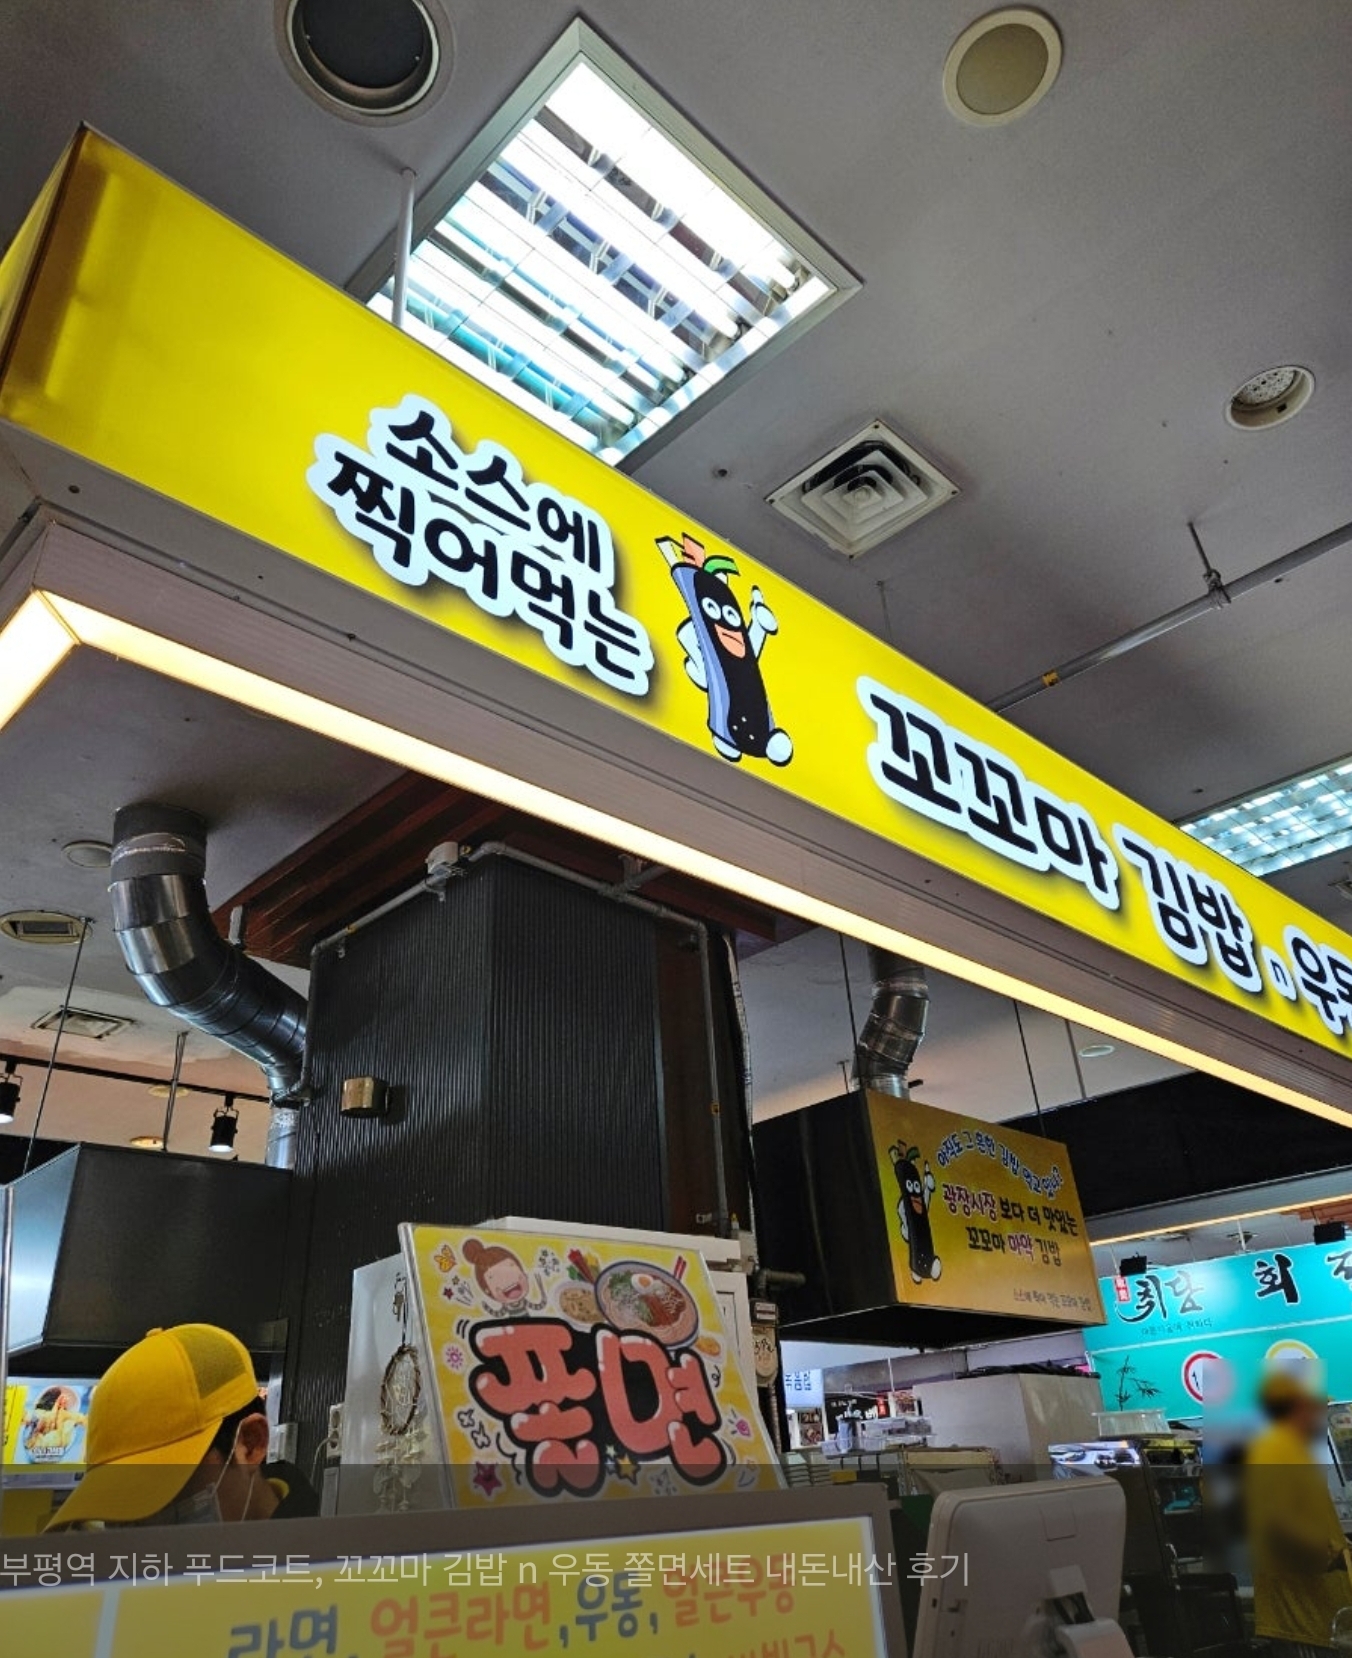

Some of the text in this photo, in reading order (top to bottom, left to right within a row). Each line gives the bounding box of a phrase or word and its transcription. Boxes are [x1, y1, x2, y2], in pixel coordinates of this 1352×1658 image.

[387, 410, 602, 572] 소스에
[327, 450, 641, 681] 찍어먹는
[870, 692, 1108, 893] 꼬꼬마
[1122, 837, 1253, 980] 김밥
[1270, 957, 1289, 987] n
[937, 1133, 964, 1167] 아직도
[963, 1131, 974, 1149] 그
[975, 1131, 996, 1158] 흔한
[998, 1144, 1020, 1176] 김밥
[1022, 1166, 1042, 1193] 먹고
[942, 1184, 1079, 1237] 광장시장 보다 더 맛있는
[966, 1226, 1062, 1267] 꼬꼬마 마약 김밥
[1255, 1254, 1299, 1303] 회
[471, 1319, 725, 1495] 쫄면
